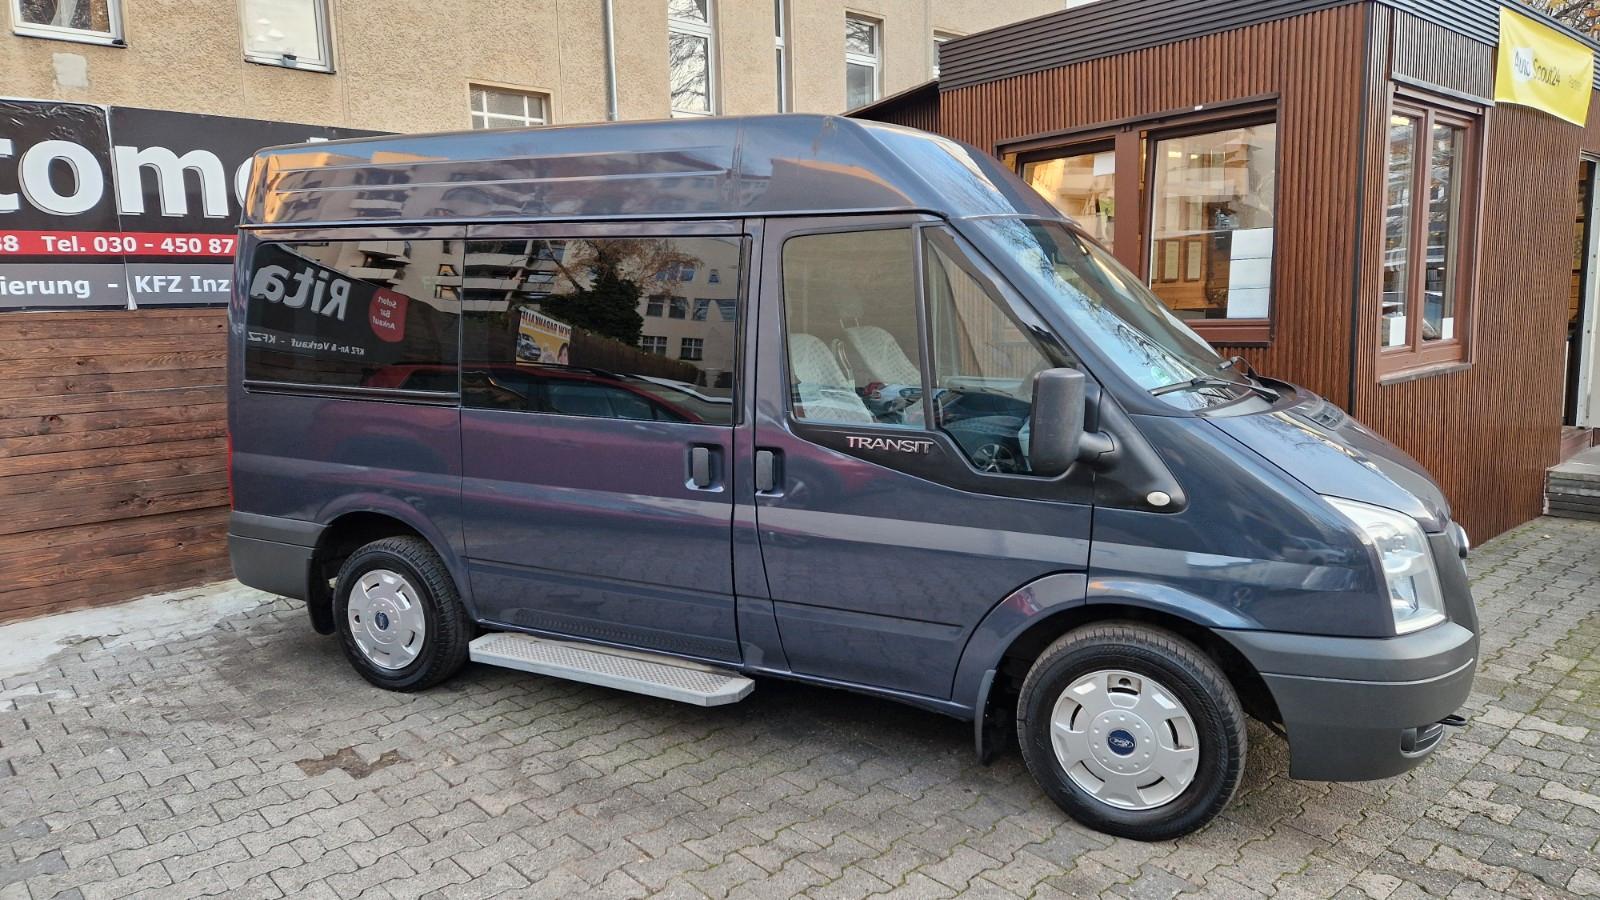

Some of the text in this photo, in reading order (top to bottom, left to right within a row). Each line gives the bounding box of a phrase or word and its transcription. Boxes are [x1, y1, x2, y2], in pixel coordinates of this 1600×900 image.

[40, 235, 86, 252] Tel.
[93, 236, 137, 252] 030
[160, 237, 202, 253] 450
[208, 238, 234, 254] 87
[134, 275, 183, 293] KFZ
[190, 275, 232, 293] Inz
[845, 435, 935, 455] TRANSIT
